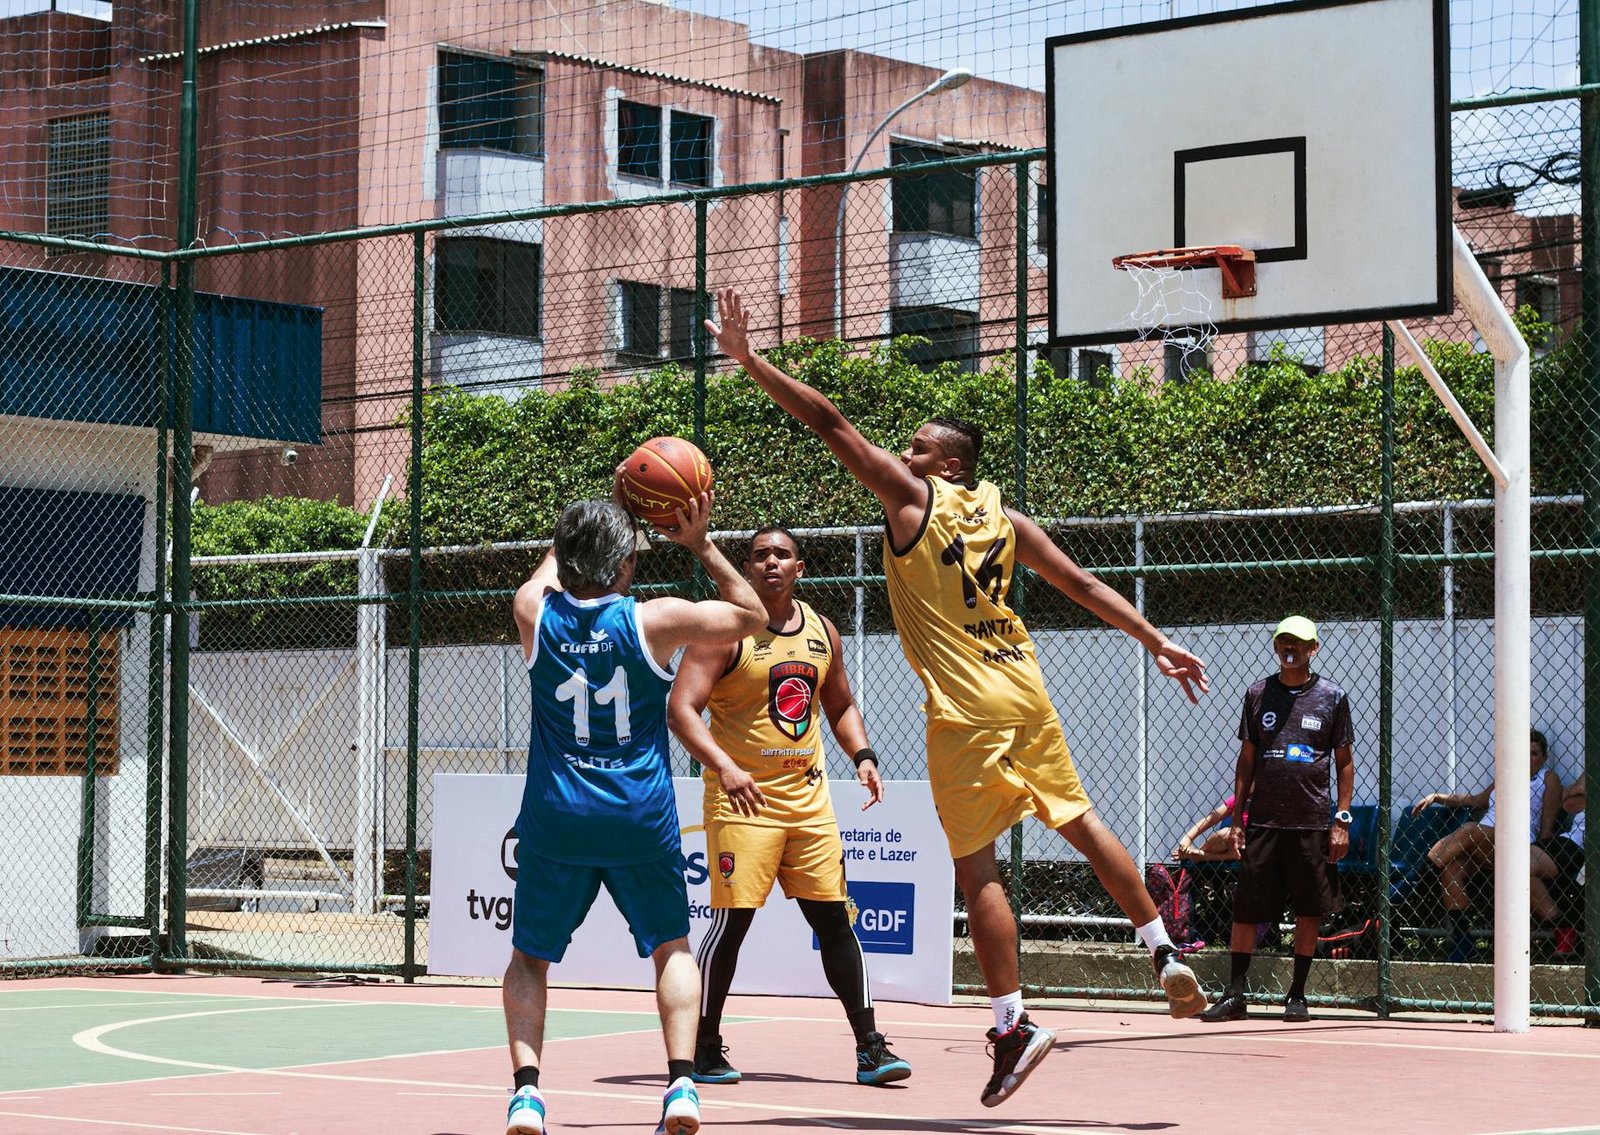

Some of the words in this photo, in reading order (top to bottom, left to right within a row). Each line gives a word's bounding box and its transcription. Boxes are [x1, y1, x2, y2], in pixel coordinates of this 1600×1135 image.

[560, 642, 599, 654] CUFA
[601, 642, 614, 652] DF
[555, 665, 631, 746] 11
[886, 829, 902, 842] de
[868, 849, 876, 860] e
[880, 847, 917, 861] Lazer
[861, 908, 907, 932] GDF
